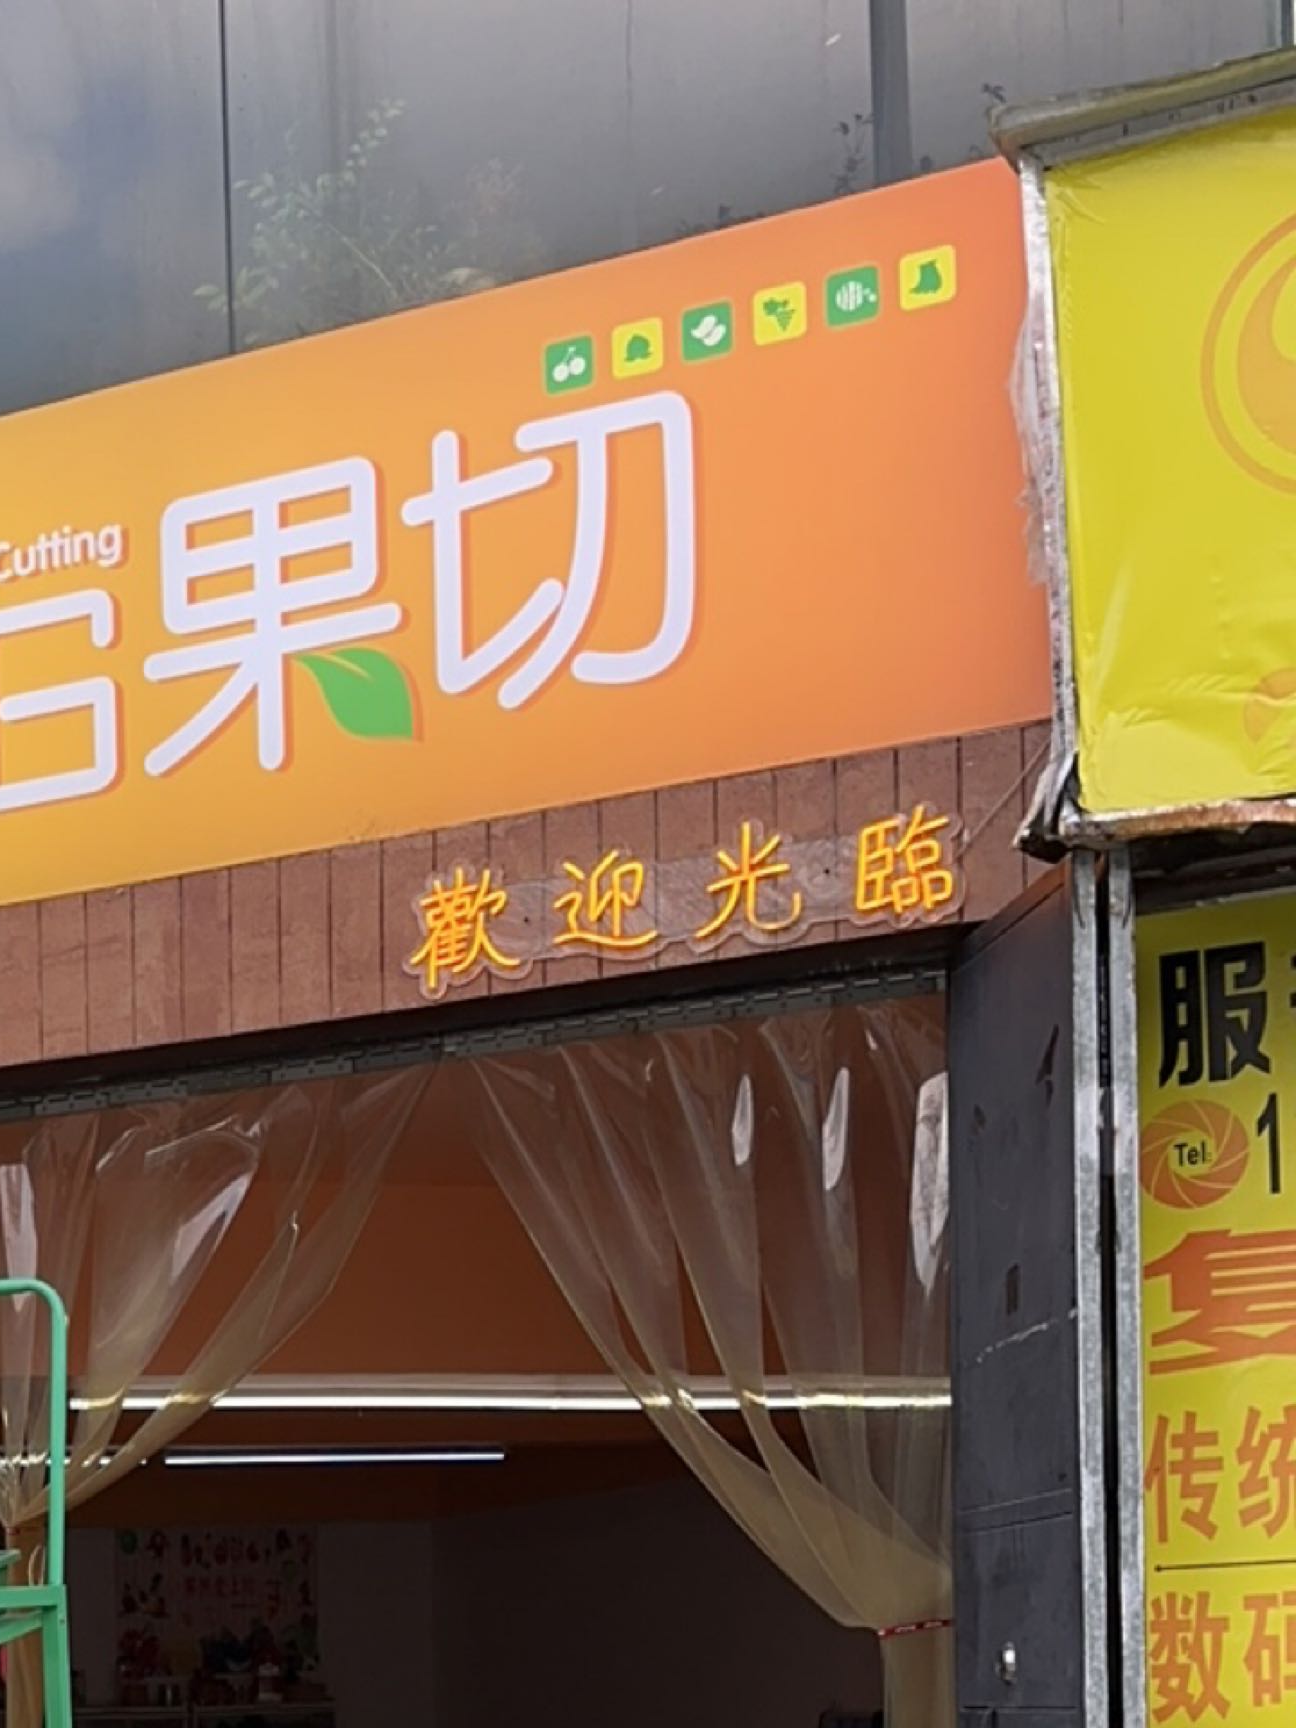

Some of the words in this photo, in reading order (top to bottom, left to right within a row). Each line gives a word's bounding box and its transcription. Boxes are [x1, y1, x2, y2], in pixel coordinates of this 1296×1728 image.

[411, 804, 954, 990] 歡迎光臨
[1159, 940, 1296, 1088] 服
